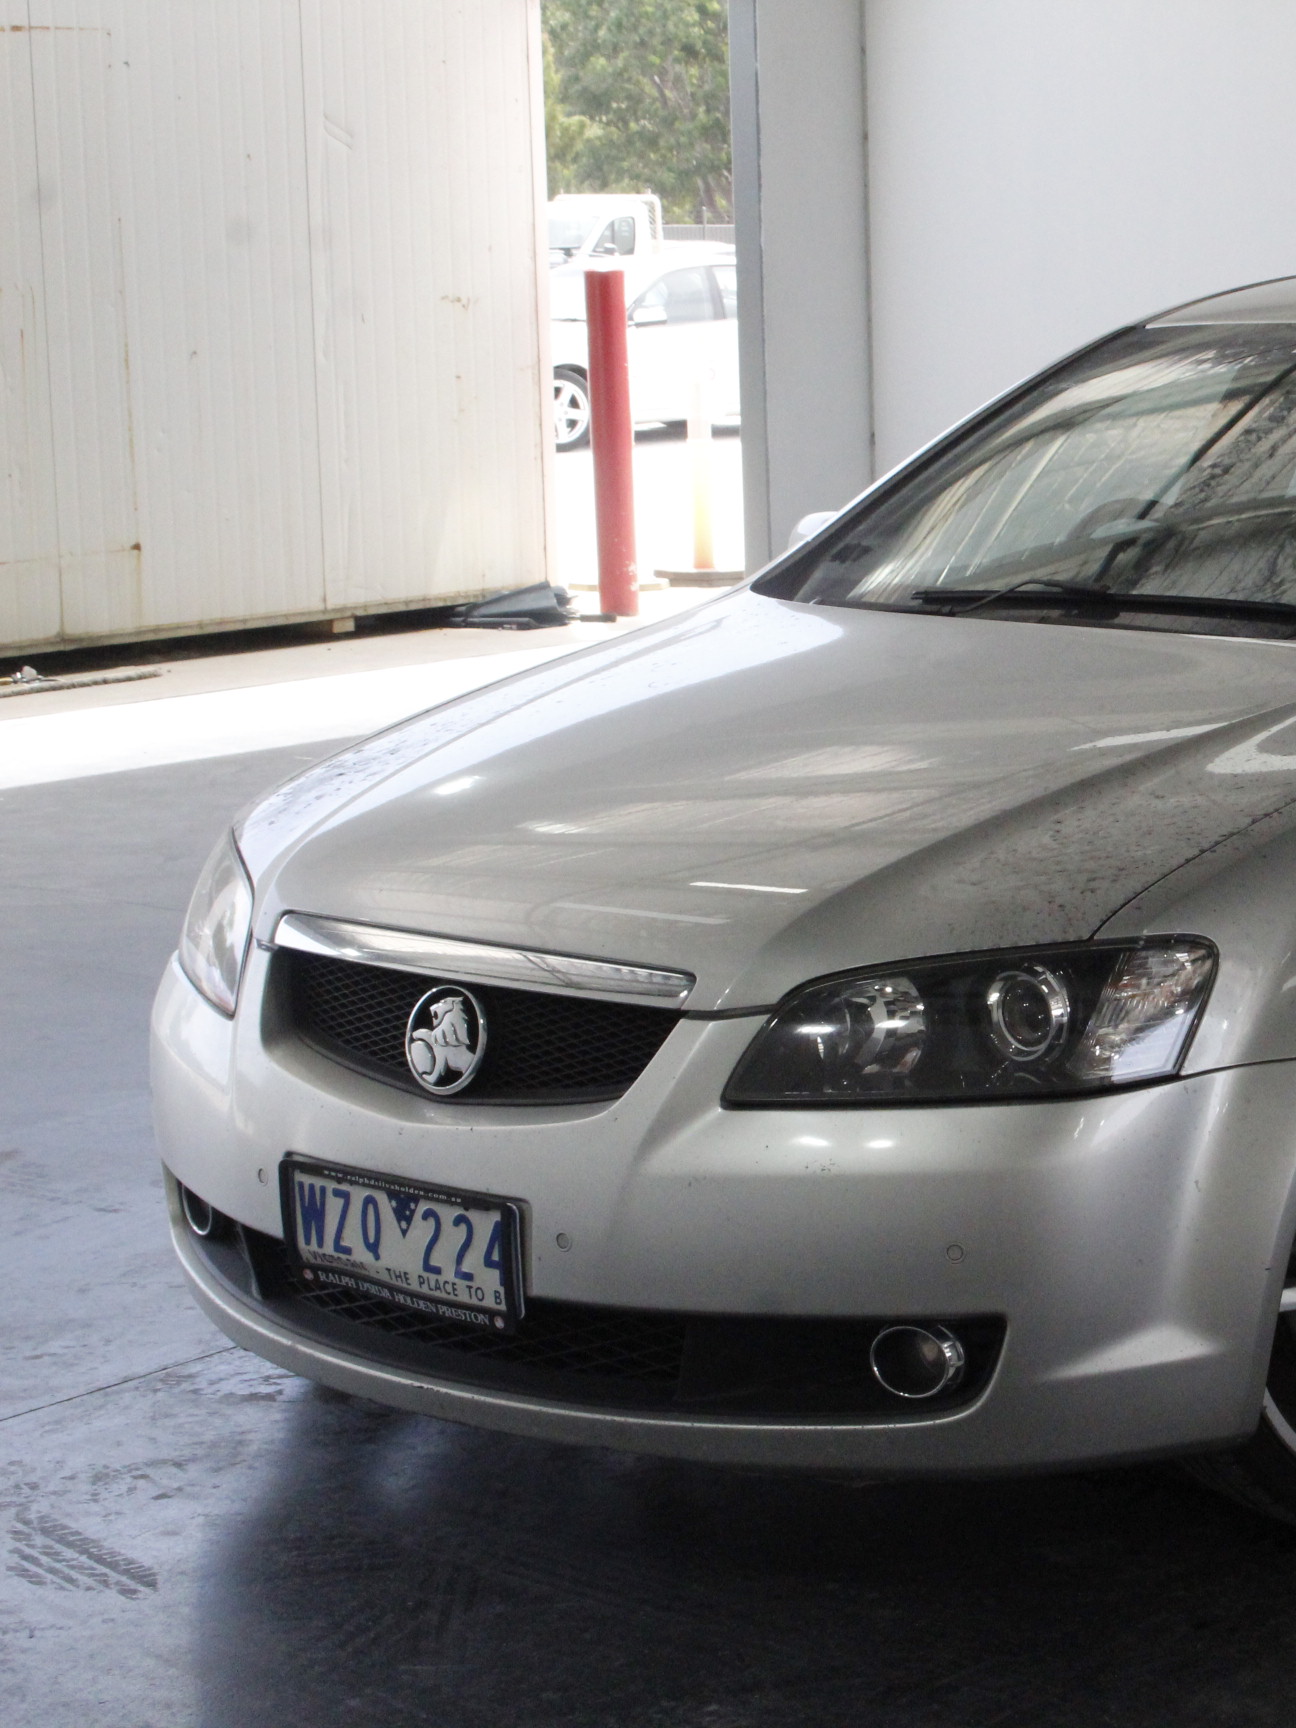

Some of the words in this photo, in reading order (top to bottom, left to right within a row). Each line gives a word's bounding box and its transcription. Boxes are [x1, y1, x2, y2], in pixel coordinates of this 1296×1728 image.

[298, 1181, 381, 1261] WZQ
[421, 1207, 505, 1287] 224
[317, 1270, 357, 1289] RALPH
[393, 1291, 437, 1313] HOLDEN
[437, 1304, 490, 1325] PRESTON
[385, 1267, 411, 1286] THE
[418, 1274, 458, 1297] PLACE
[466, 1285, 485, 1302] TO
